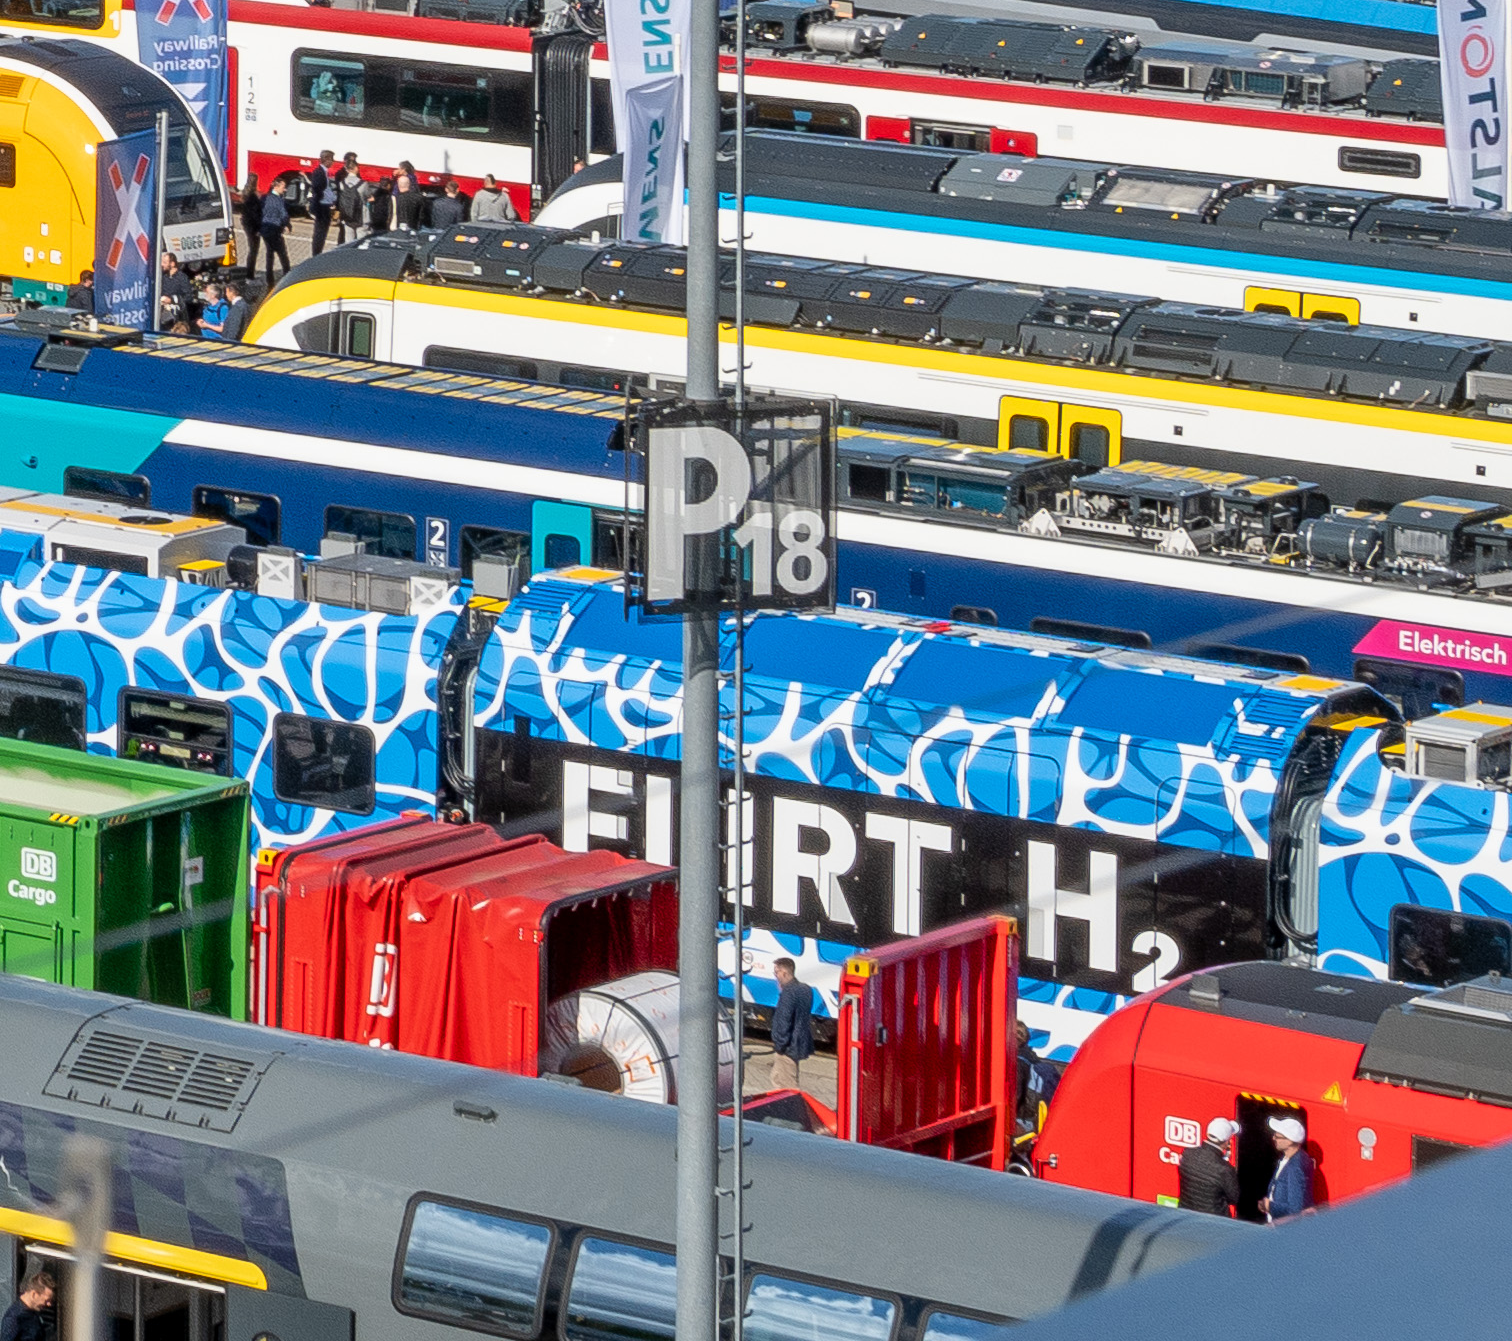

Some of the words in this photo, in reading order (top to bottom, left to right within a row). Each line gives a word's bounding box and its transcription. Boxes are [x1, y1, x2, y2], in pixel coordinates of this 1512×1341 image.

[648, 427, 751, 601] P
[734, 511, 828, 597] 18
[430, 520, 445, 547] 2
[1398, 629, 1507, 665] Elektrisch
[25, 851, 53, 879] DB
[7, 879, 57, 906] Cargo
[1168, 1122, 1197, 1145] DB
